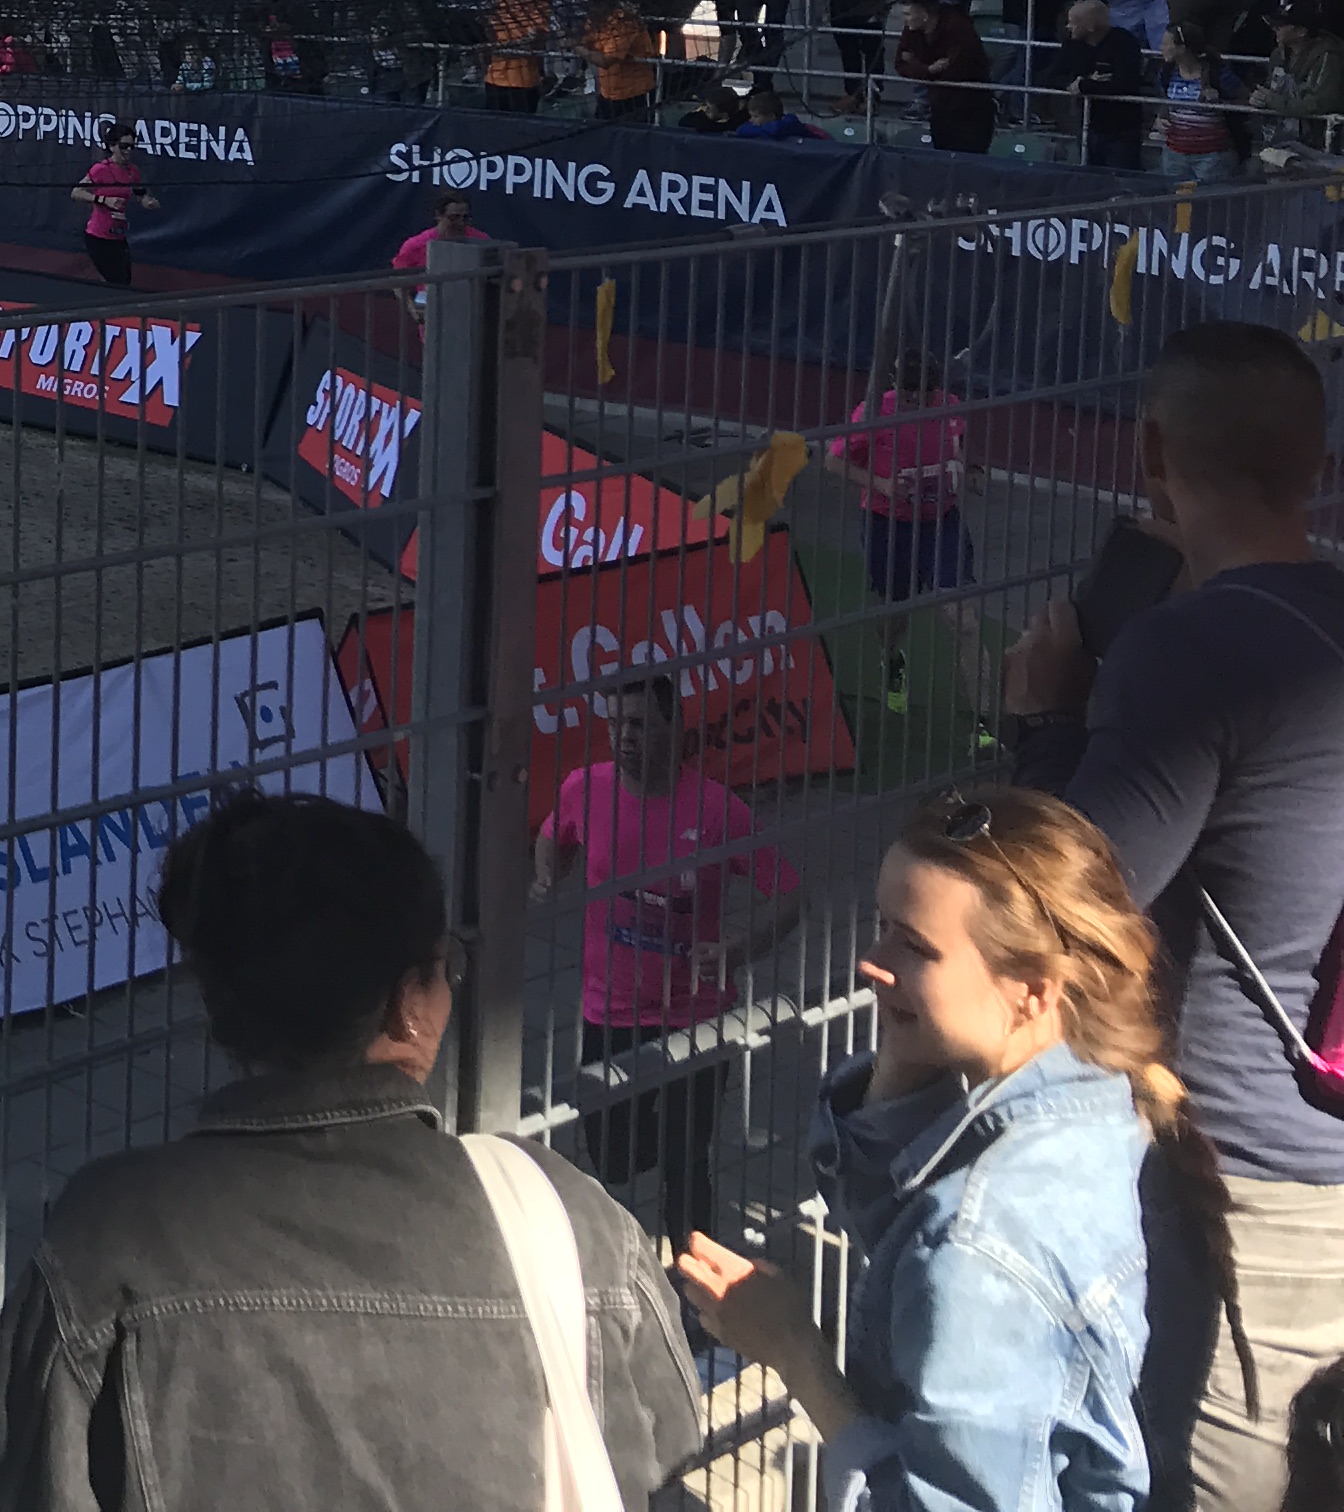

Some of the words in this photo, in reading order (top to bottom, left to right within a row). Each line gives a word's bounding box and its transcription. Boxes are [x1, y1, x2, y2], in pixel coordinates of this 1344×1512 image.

[134, 119, 255, 166] ARENA
[385, 142, 616, 206] SHOPPING
[624, 169, 788, 228] ARENA
[533, 604, 796, 734] t.Gallen
[25, 886, 164, 958] STEPHAN
